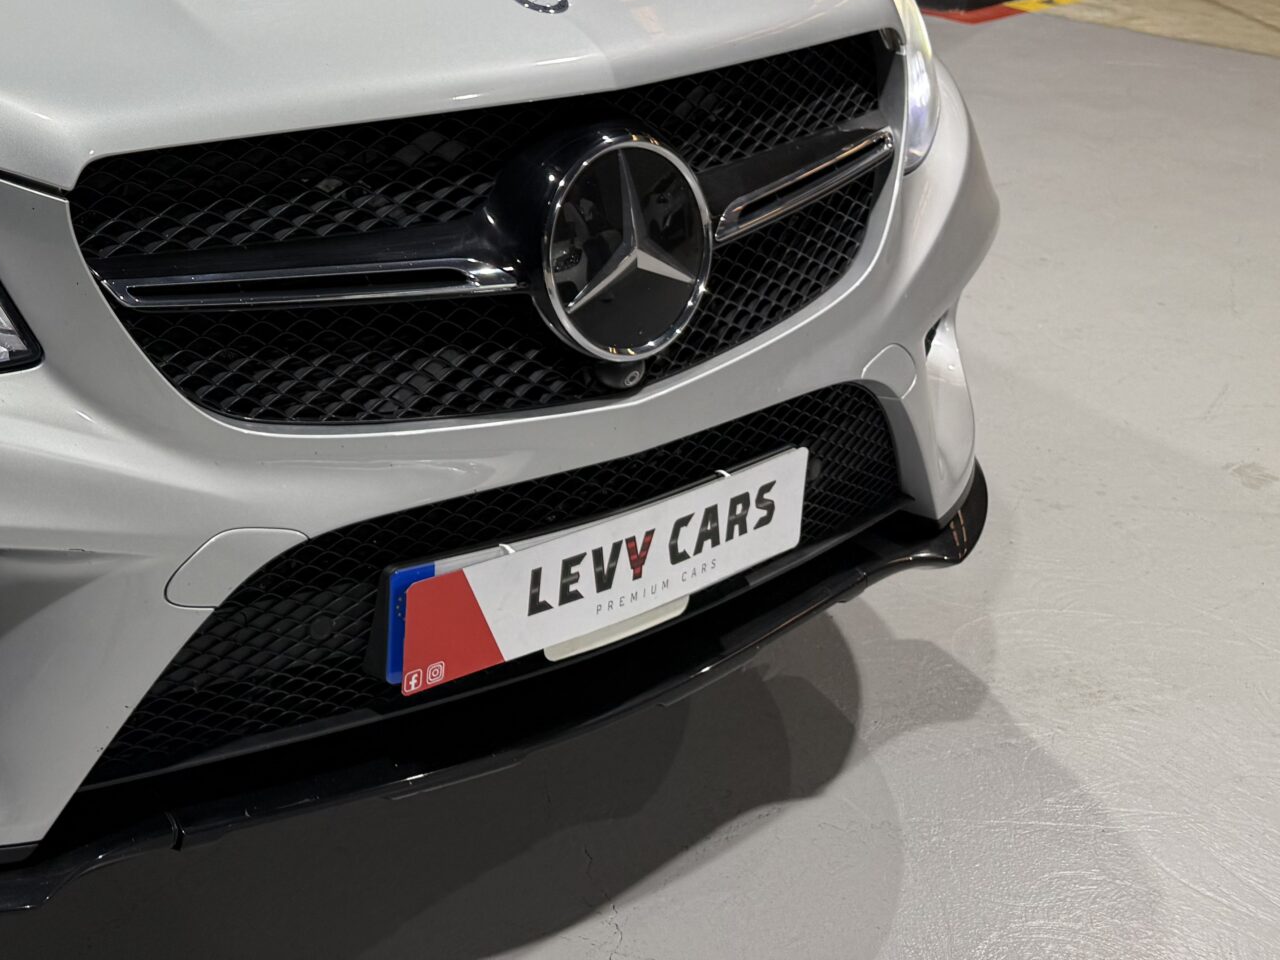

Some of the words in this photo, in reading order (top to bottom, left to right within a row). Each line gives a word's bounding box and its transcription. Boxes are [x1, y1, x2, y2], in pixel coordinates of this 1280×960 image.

[527, 528, 656, 617] LEVY
[668, 480, 777, 566] CARS
[596, 579, 670, 615] PREMIUM
[681, 558, 718, 582] CARS
